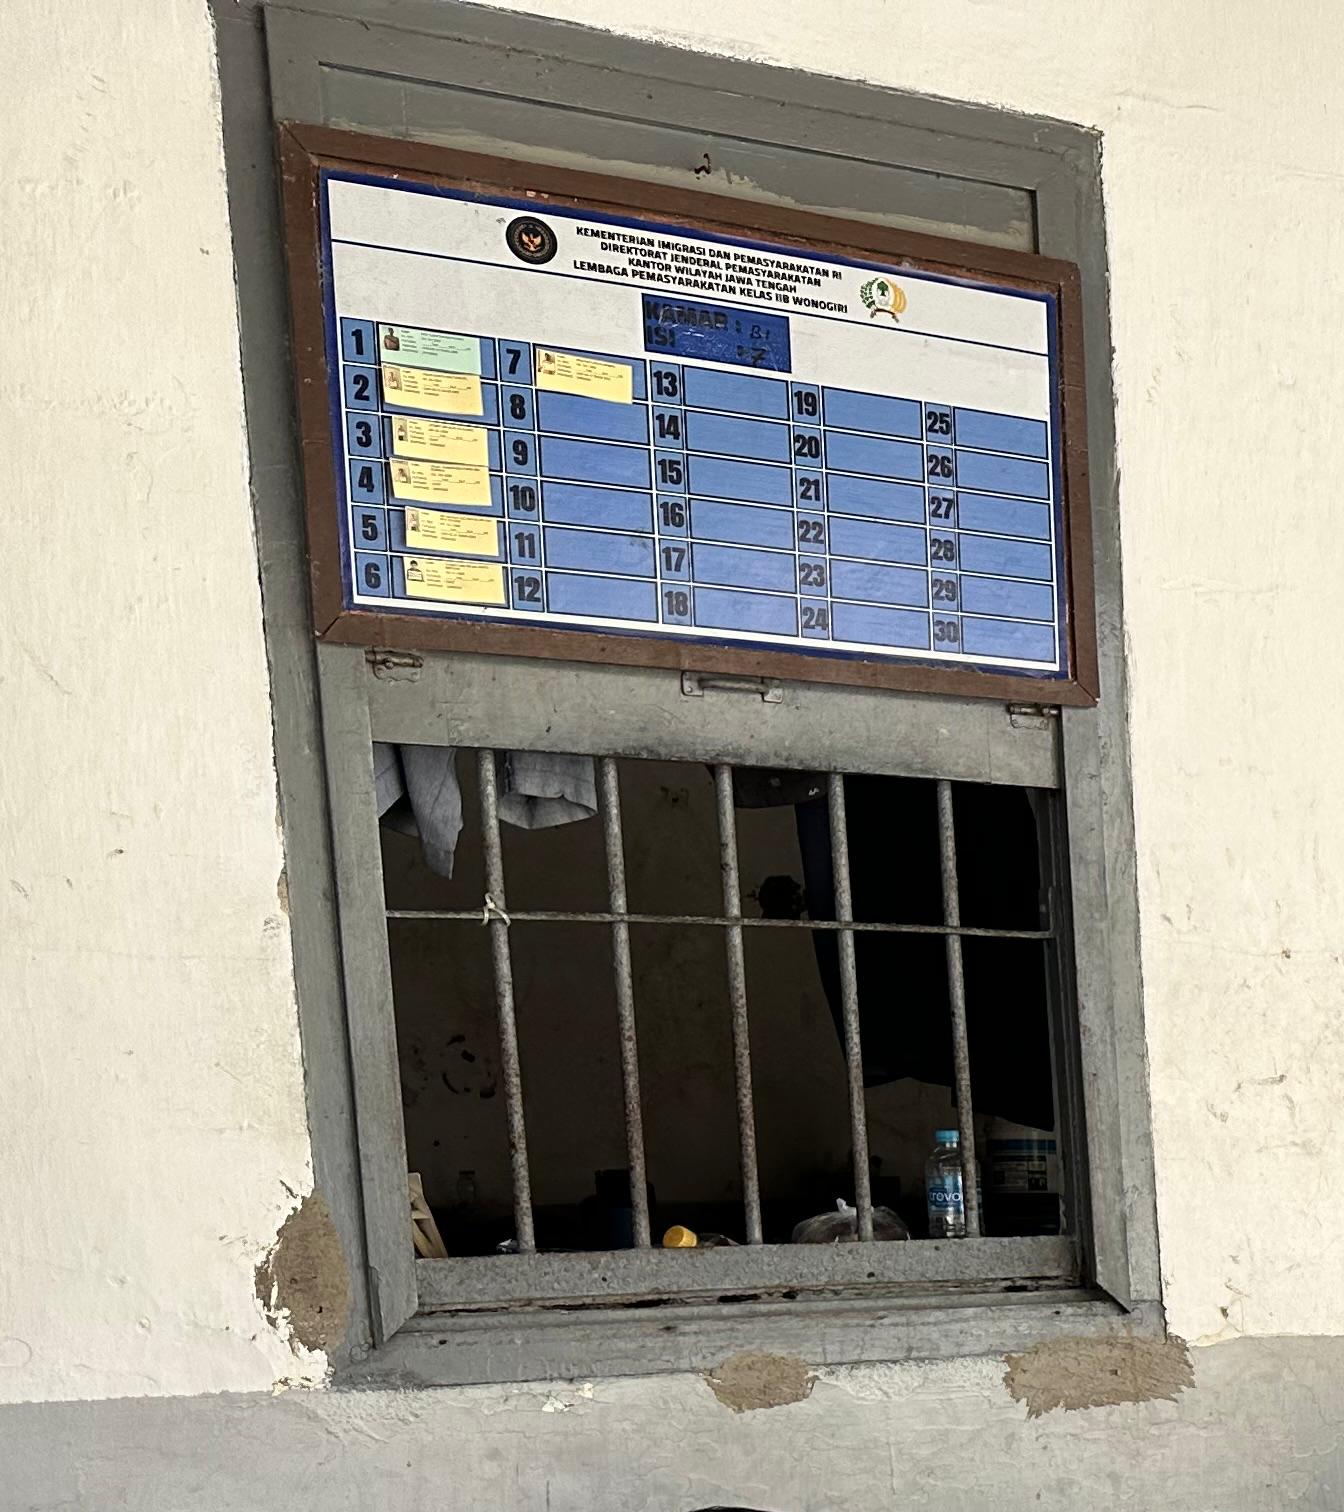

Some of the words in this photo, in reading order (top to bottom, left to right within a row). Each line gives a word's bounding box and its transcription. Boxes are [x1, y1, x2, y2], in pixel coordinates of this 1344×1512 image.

[576, 227, 655, 247] KEMENTERIAN
[658, 239, 706, 256] IMIGRASI
[709, 248, 731, 260] DAN
[733, 252, 829, 277] PEMASYARAKATAN
[832, 271, 842, 280] RI
[601, 241, 668, 261] DIREKTORAT
[670, 253, 723, 270] JENDERAL
[725, 262, 821, 287] PEMASYARAKATAN
[573, 260, 628, 277] LEMBAGA
[632, 269, 736, 295] PEMASYARAKATAN
[740, 287, 772, 301] KELAS
[792, 296, 848, 313] WONOGIRI
[628, 257, 671, 272] KANTOR
[674, 265, 722, 280] WILAYAH
[725, 274, 753, 286] JAWA
[755, 279, 797, 293] TENGAH
[646, 302, 728, 330] KAMAR
[351, 329, 364, 355] 1
[647, 325, 676, 347] ISI
[506, 348, 521, 374] 7
[353, 374, 369, 401] 2
[653, 370, 678, 397] 13
[509, 394, 526, 420] 8
[794, 390, 817, 416] 19
[356, 421, 372, 448] 3
[655, 413, 681, 440] 14
[927, 411, 951, 435] 25
[512, 439, 528, 466] 9
[794, 434, 821, 459] 20
[358, 466, 375, 493] 4
[657, 459, 683, 485] 15
[928, 455, 953, 478] 26
[509, 485, 535, 512] 10
[799, 477, 821, 501] 21
[659, 502, 685, 528] 16
[930, 496, 954, 519] 27
[362, 515, 378, 541] 5
[799, 520, 824, 544] 22
[514, 532, 536, 559] 11
[930, 538, 955, 562] 28
[662, 547, 687, 573] 17
[365, 562, 381, 589] 6
[799, 563, 825, 587] 23
[514, 576, 541, 603] 12
[931, 579, 957, 602] 29
[664, 590, 688, 617] 18
[802, 607, 829, 631] 24
[933, 620, 959, 642] 30
